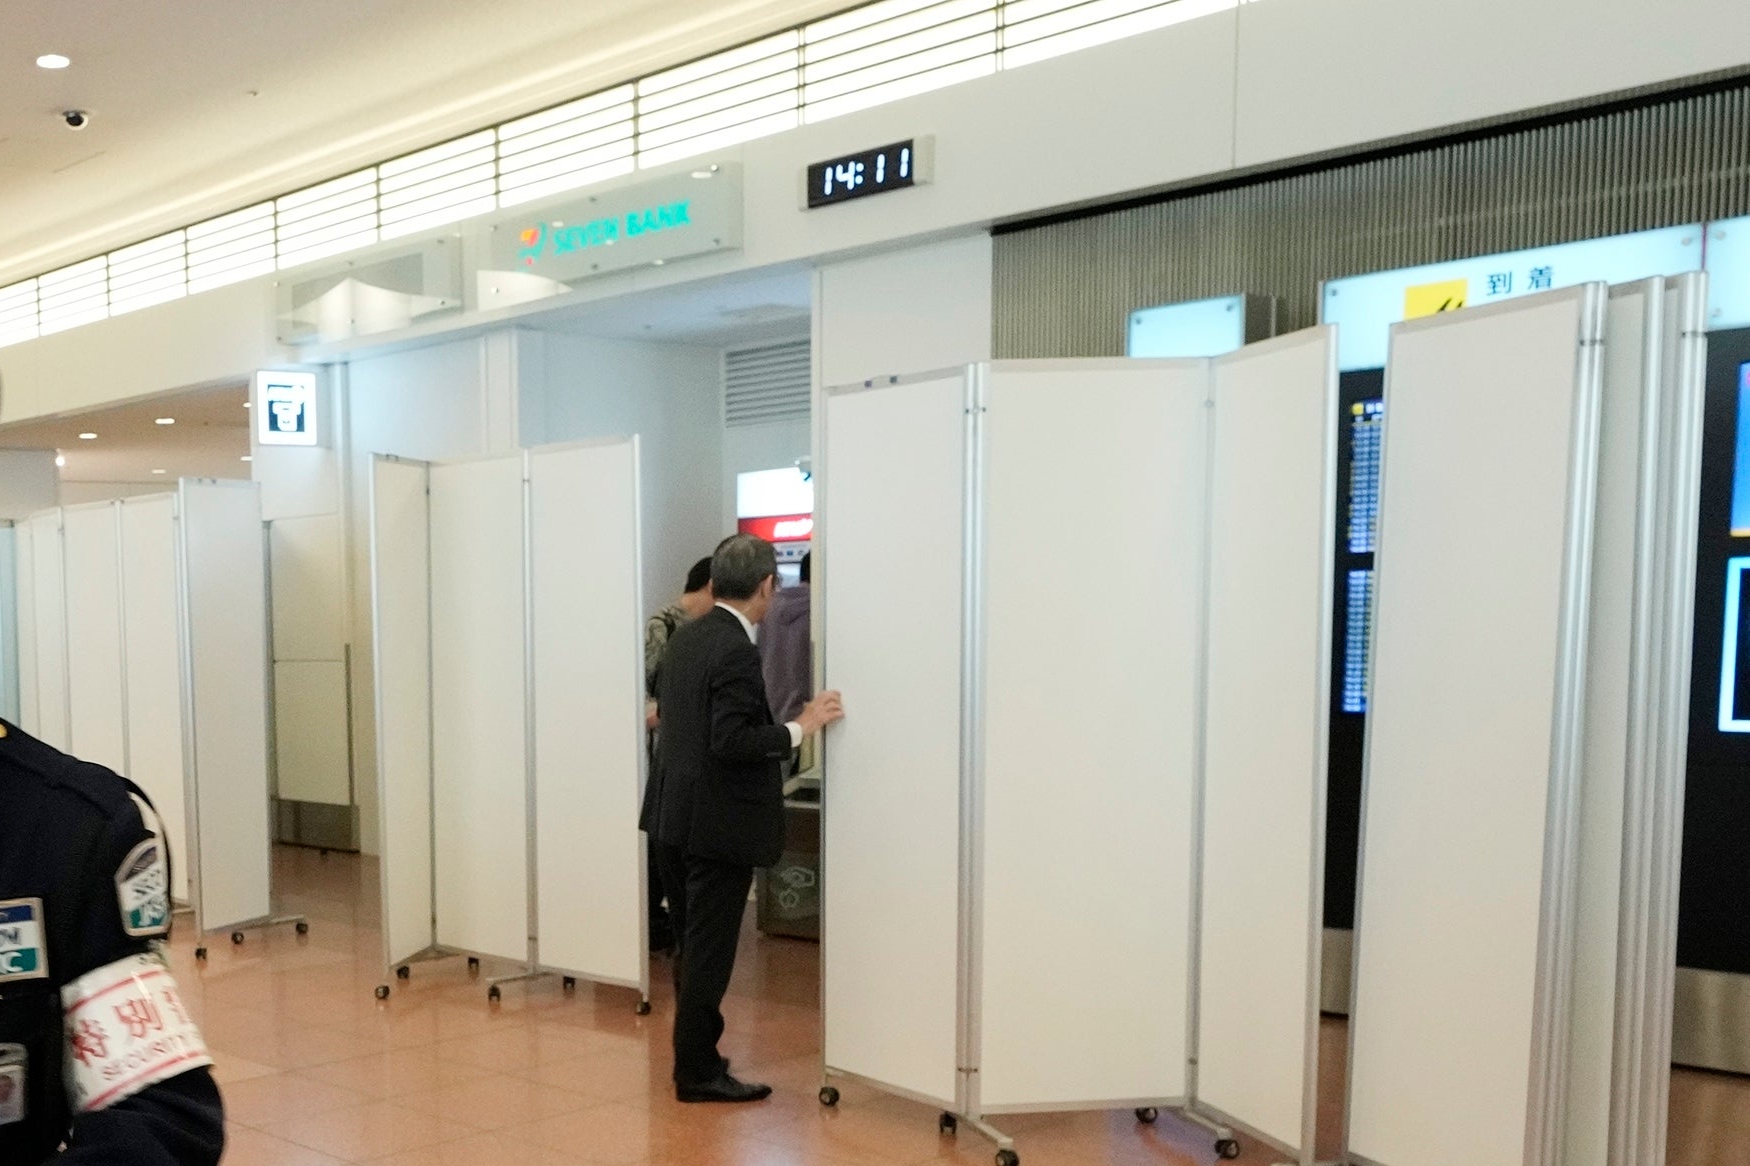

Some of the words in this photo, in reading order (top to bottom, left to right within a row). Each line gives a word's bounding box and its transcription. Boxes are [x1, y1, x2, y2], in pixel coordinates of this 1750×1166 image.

[824, 148, 909, 195] 14:11
[553, 216, 620, 255] SEVEN
[625, 198, 691, 237] BANK
